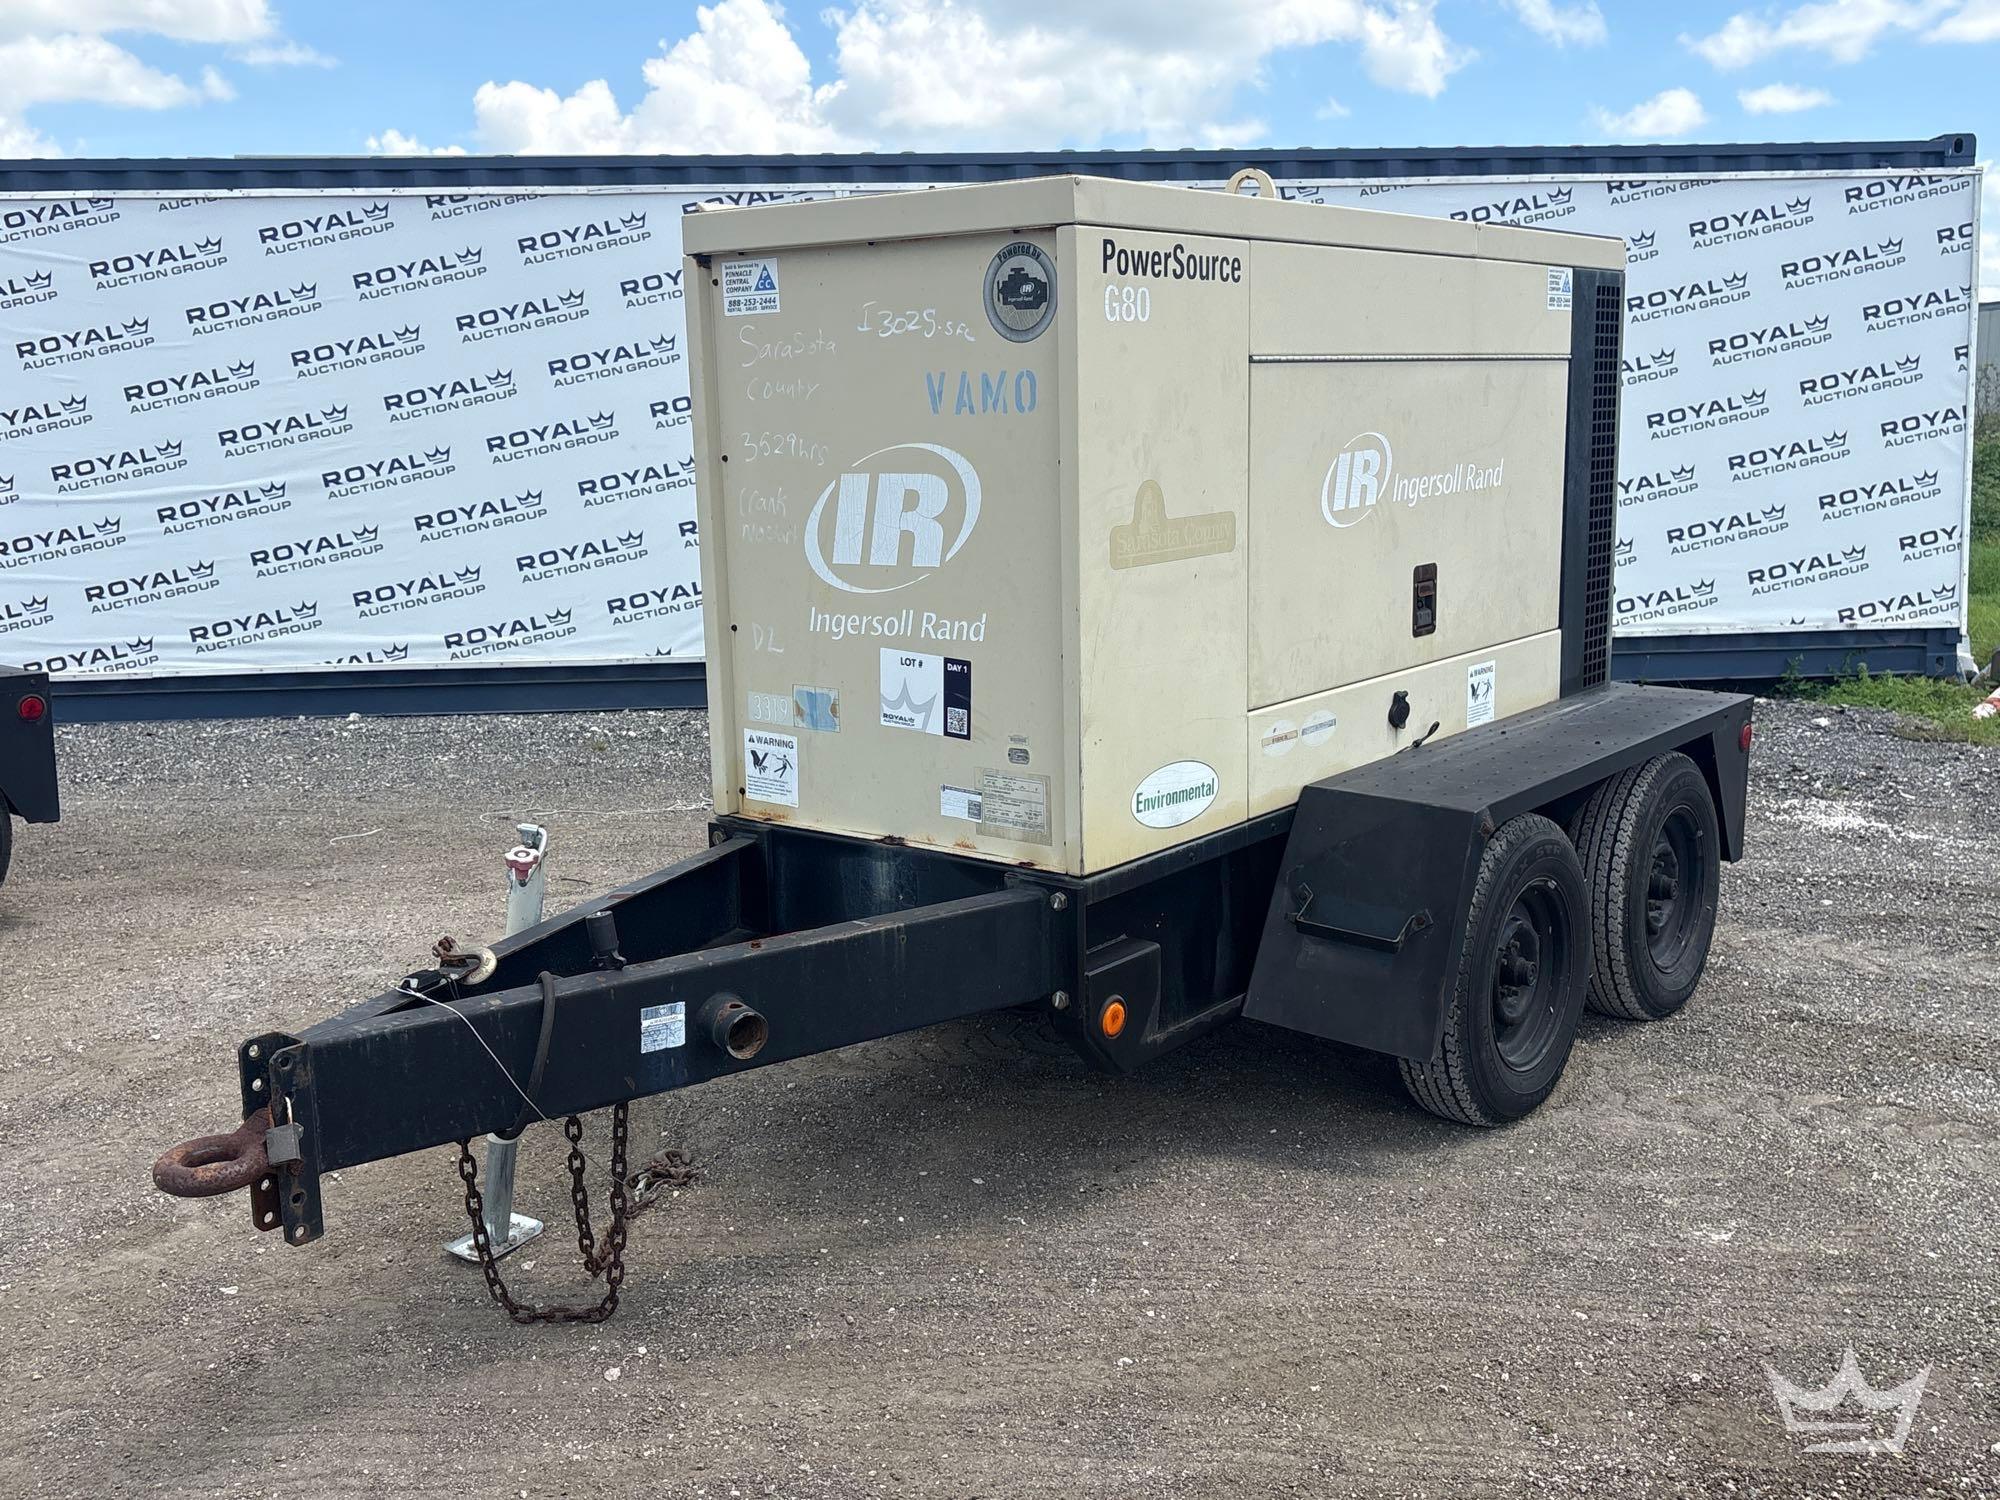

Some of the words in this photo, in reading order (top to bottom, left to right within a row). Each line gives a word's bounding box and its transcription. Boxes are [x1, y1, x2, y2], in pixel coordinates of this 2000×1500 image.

[1849, 193, 1914, 215] AUCTION
[1918, 180, 1970, 199] GROUP
[258, 211, 364, 244] ROYAL
[518, 221, 621, 254] ROYAL
[1689, 205, 1786, 237] ROYAL
[1693, 228, 1758, 249] AUCTION
[1762, 216, 1814, 234] GROUP
[266, 234, 336, 256] AUCTION
[339, 222, 394, 240] GROUP
[524, 244, 593, 265] AUCTION
[596, 232, 651, 250] GROUP
[997, 243, 1031, 262] Powered
[1032, 247, 1041, 260] by
[89, 245, 197, 278] ROYAL
[96, 269, 168, 290] AUCTION
[171, 257, 227, 275] GROUP
[353, 256, 457, 289] ROYAL
[725, 270, 752, 278] PINNACLE
[1102, 238, 1242, 283] PowerSource
[1781, 246, 1878, 278] ROYAL
[1785, 268, 1850, 290] AUCTION
[1854, 256, 1905, 274] GROUP
[359, 279, 429, 301] AUCTION
[432, 267, 487, 285] GROUP
[725, 278, 749, 286] CENTRAL
[725, 285, 753, 294] COMPANY
[1627, 280, 1723, 312] ROYAL
[186, 291, 291, 324] ROYAL
[193, 314, 263, 336] AUCTION
[266, 302, 322, 320] GROUP
[456, 298, 559, 331] ROYAL
[1104, 284, 1151, 322] G80
[1631, 302, 1696, 324] AUCTION
[1699, 291, 1750, 309] GROUP
[1863, 288, 1960, 321] ROYAL
[462, 321, 531, 343] AUCTION
[534, 309, 589, 327] GROUP
[1867, 311, 1932, 332] AUCTION
[16, 326, 124, 359] ROYAL
[23, 349, 95, 371] AUCTION
[98, 337, 154, 355] GROUP
[291, 334, 395, 367] ROYAL
[1709, 323, 1804, 355] ROYAL
[1713, 345, 1777, 366] AUCTION
[1781, 333, 1832, 351] GROUP
[297, 357, 367, 379] AUCTION
[370, 344, 425, 363] GROUP
[548, 343, 651, 376] ROYAL
[554, 366, 623, 388] AUCTION
[626, 354, 681, 372] GROUP
[124, 369, 229, 402] ROYAL
[384, 378, 487, 411] ROYAL
[926, 369, 1038, 415] VAMO
[1800, 363, 1895, 395] ROYAL
[1804, 385, 1868, 406] AUCTION
[1872, 373, 1923, 391] GROUP
[131, 392, 201, 414] AUCTION
[204, 380, 260, 398] GROUP
[390, 401, 459, 423] AUCTION
[462, 389, 517, 407] GROUP
[1647, 397, 1742, 429] ROYAL
[218, 413, 323, 446] ROYAL
[486, 420, 589, 453] ROYAL
[1651, 419, 1715, 440] AUCTION
[1719, 408, 1769, 425] GROUP
[225, 436, 295, 458] AUCTION
[298, 424, 353, 442] GROUP
[493, 443, 561, 464] AUCTION
[565, 431, 619, 448] GROUP
[1728, 439, 1823, 470] ROYAL
[51, 448, 157, 481] ROYAL
[58, 471, 129, 494] AUCTION
[132, 459, 187, 478] GROUP
[322, 455, 425, 488] ROYAL
[578, 463, 680, 496] ROYAL
[1332, 449, 1381, 512] IR
[1733, 461, 1796, 482] AUCTION
[1800, 449, 1850, 467] GROUP
[328, 477, 398, 499] AUCTION
[401, 465, 455, 483] GROUP
[584, 486, 652, 508] AUCTION
[1393, 463, 1463, 507] Ingersoll
[1465, 458, 1504, 492] Rand
[1819, 478, 1914, 510] ROYAL
[157, 490, 261, 523] ROYAL
[164, 513, 233, 535] AUCTION
[236, 501, 291, 519] GROUP
[414, 498, 517, 531] ROYAL
[832, 473, 949, 568] IR
[1823, 500, 1887, 521] AUCTION
[1890, 488, 1941, 506] GROUP
[420, 521, 489, 543] AUCTION
[493, 509, 547, 527] GROUP
[1667, 512, 1762, 544] ROYAL
[1671, 534, 1735, 555] AUCTION
[1738, 522, 1788, 540] GROUP
[250, 533, 353, 566] ROYAL
[257, 556, 326, 578] AUCTION
[329, 544, 383, 562] GROUP
[516, 539, 618, 572] ROYAL
[522, 562, 591, 583] AUCTION
[594, 550, 648, 567] GROUP
[1748, 553, 1842, 585] ROYAL
[1752, 575, 1815, 596] AUCTION
[1819, 563, 1869, 581] GROUP
[85, 569, 189, 602] ROYAL
[92, 592, 161, 614] AUCTION
[165, 580, 219, 598] GROUP
[353, 574, 456, 607] ROYAL
[359, 597, 428, 619] AUCTION
[431, 584, 485, 602] GROUP
[189, 610, 292, 643] ROYAL
[196, 632, 264, 654] AUCTION
[268, 620, 322, 638] GROUP
[444, 617, 547, 649] ROYAL
[808, 606, 913, 641] Ingersoll
[920, 612, 987, 642] Rand
[450, 639, 519, 660] AUCTION
[522, 627, 576, 645] GROUP
[900, 656, 917, 668] LOT
[947, 663, 961, 672] DAY
[883, 713, 907, 722] ROYAL
[756, 735, 794, 749] WARNING
[1136, 777, 1215, 814] Environmental
